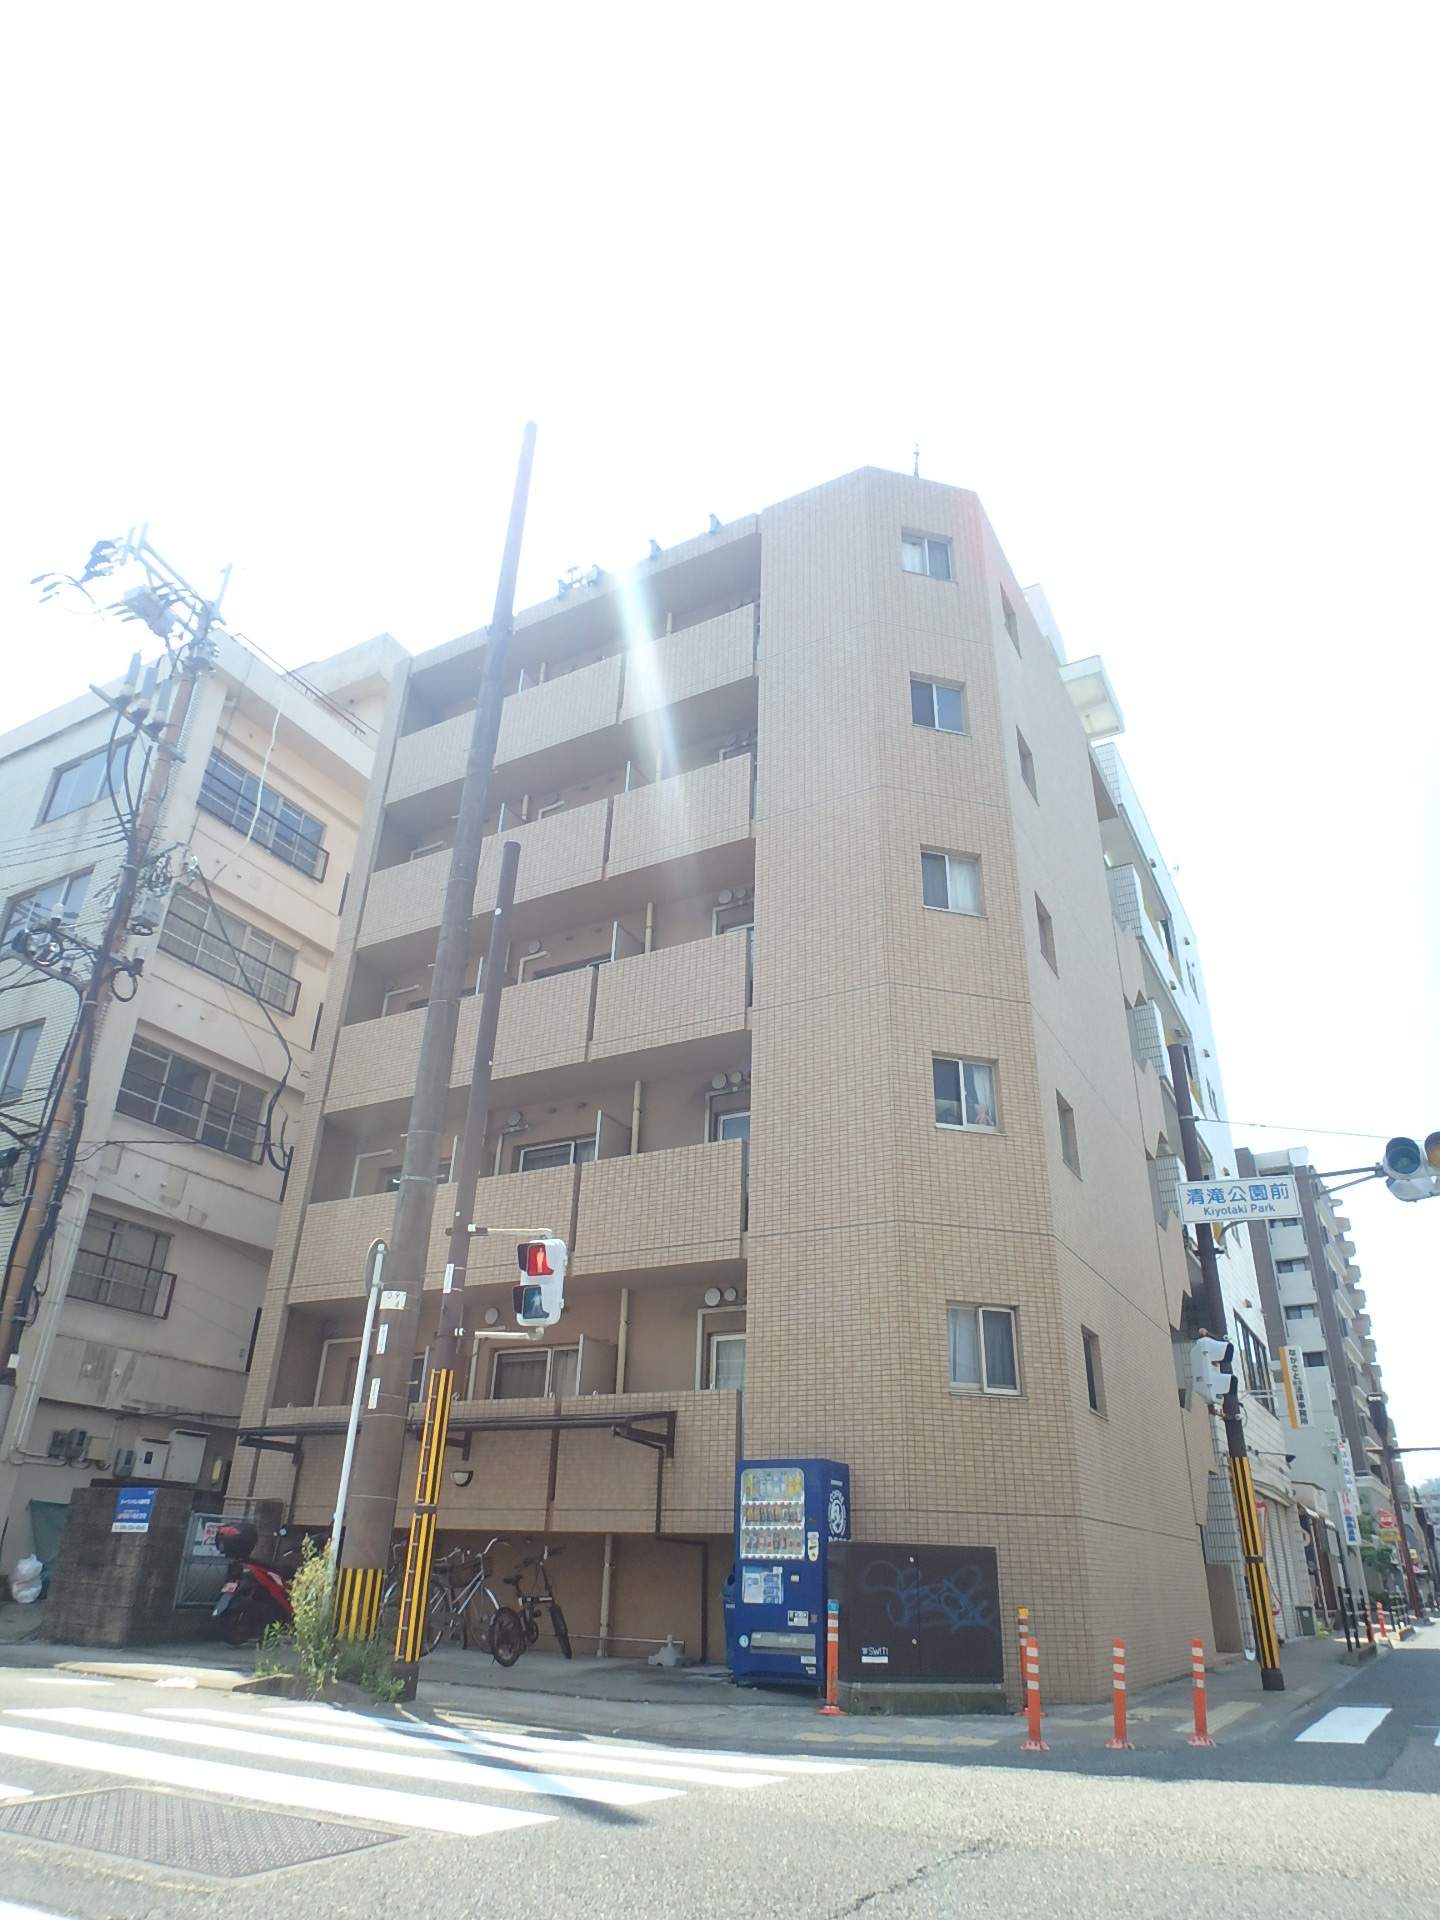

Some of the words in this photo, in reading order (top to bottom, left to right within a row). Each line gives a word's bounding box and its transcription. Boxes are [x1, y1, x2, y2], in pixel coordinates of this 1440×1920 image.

[1186, 1183, 1289, 1205] 清滝公園前
[1203, 1205, 1247, 1217] Kiyotaki
[1250, 1203, 1276, 1213] Park
